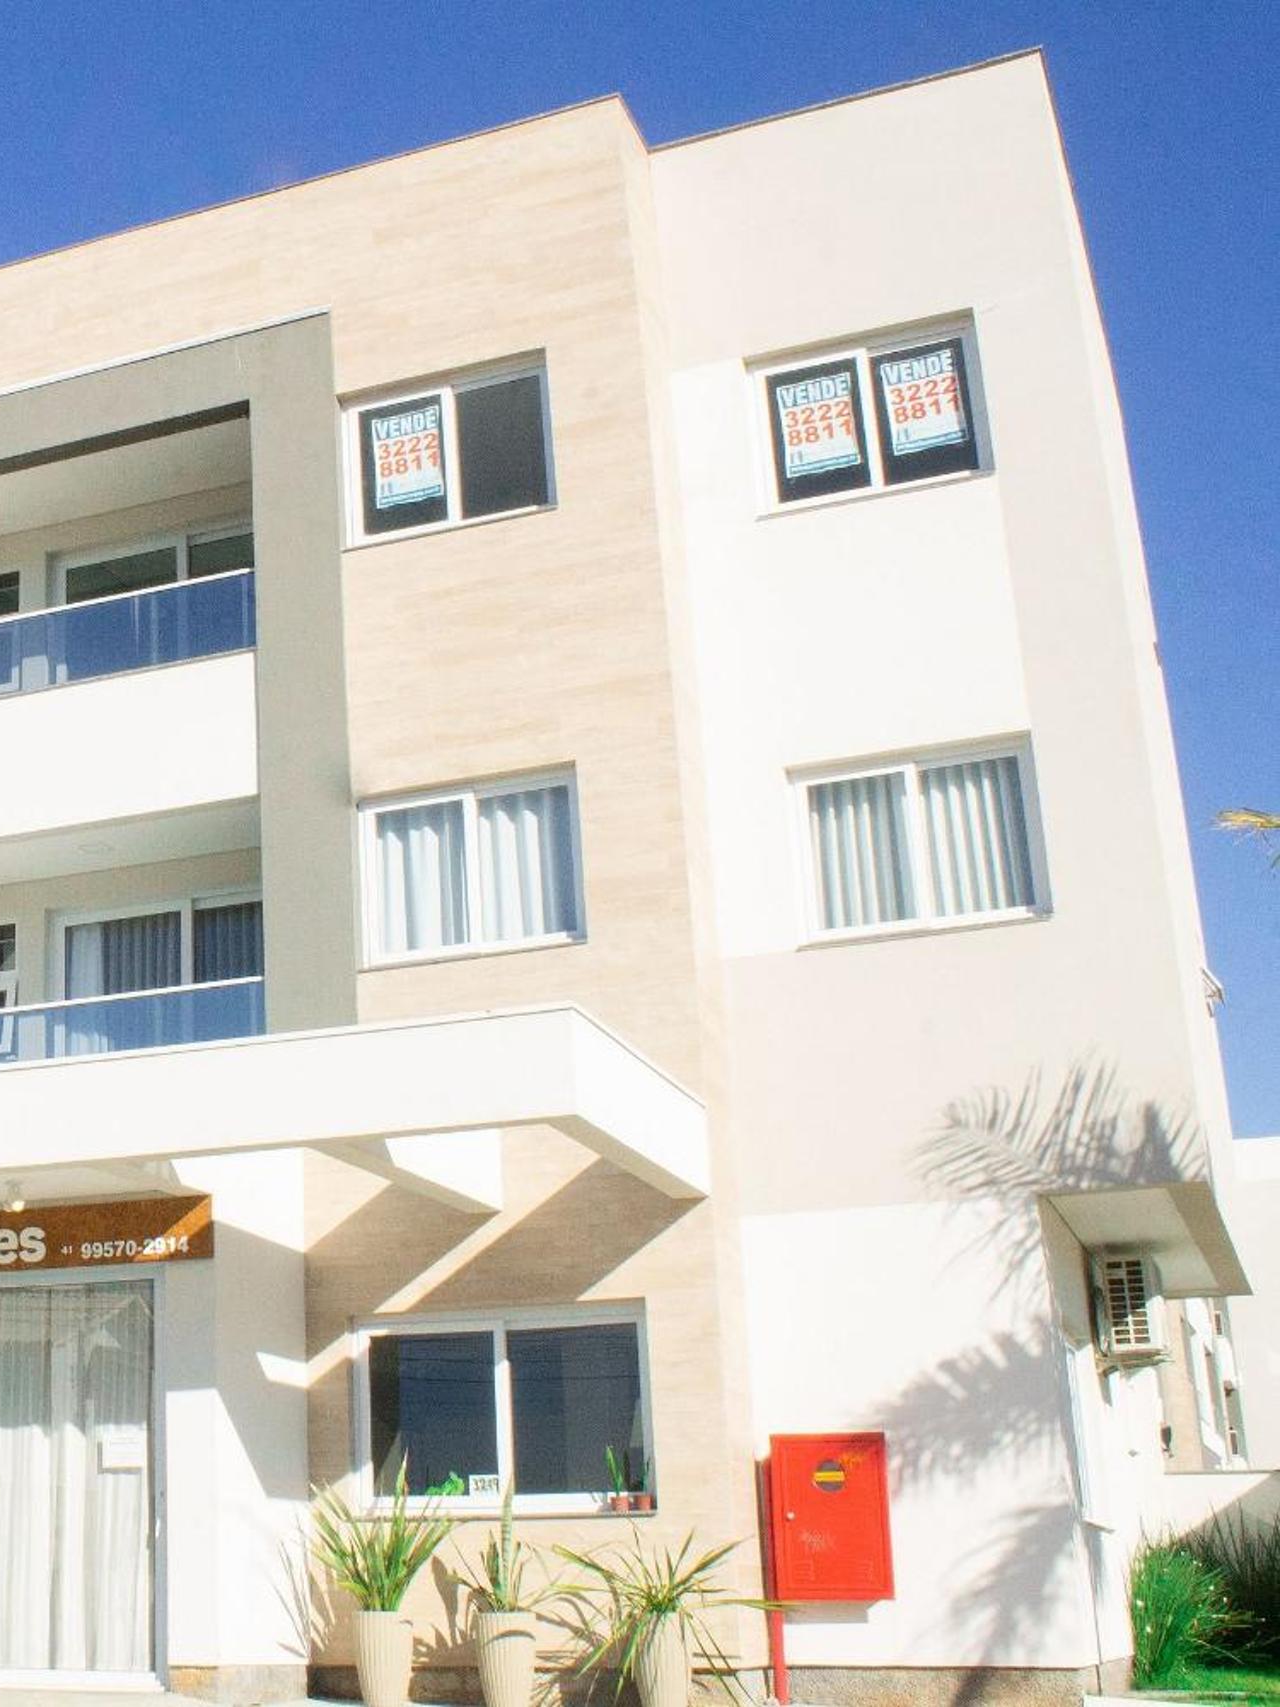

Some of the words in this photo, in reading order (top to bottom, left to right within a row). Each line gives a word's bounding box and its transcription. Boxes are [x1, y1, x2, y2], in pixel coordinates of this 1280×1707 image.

[883, 350, 953, 385] VENDE
[781, 375, 850, 408] VENDE
[890, 376, 957, 405] 3222
[785, 401, 851, 428] 3222
[894, 394, 959, 423] 8811
[374, 407, 438, 440] VENDE
[788, 419, 851, 446] 8811
[378, 433, 438, 460] 3222
[380, 451, 438, 477] 8811
